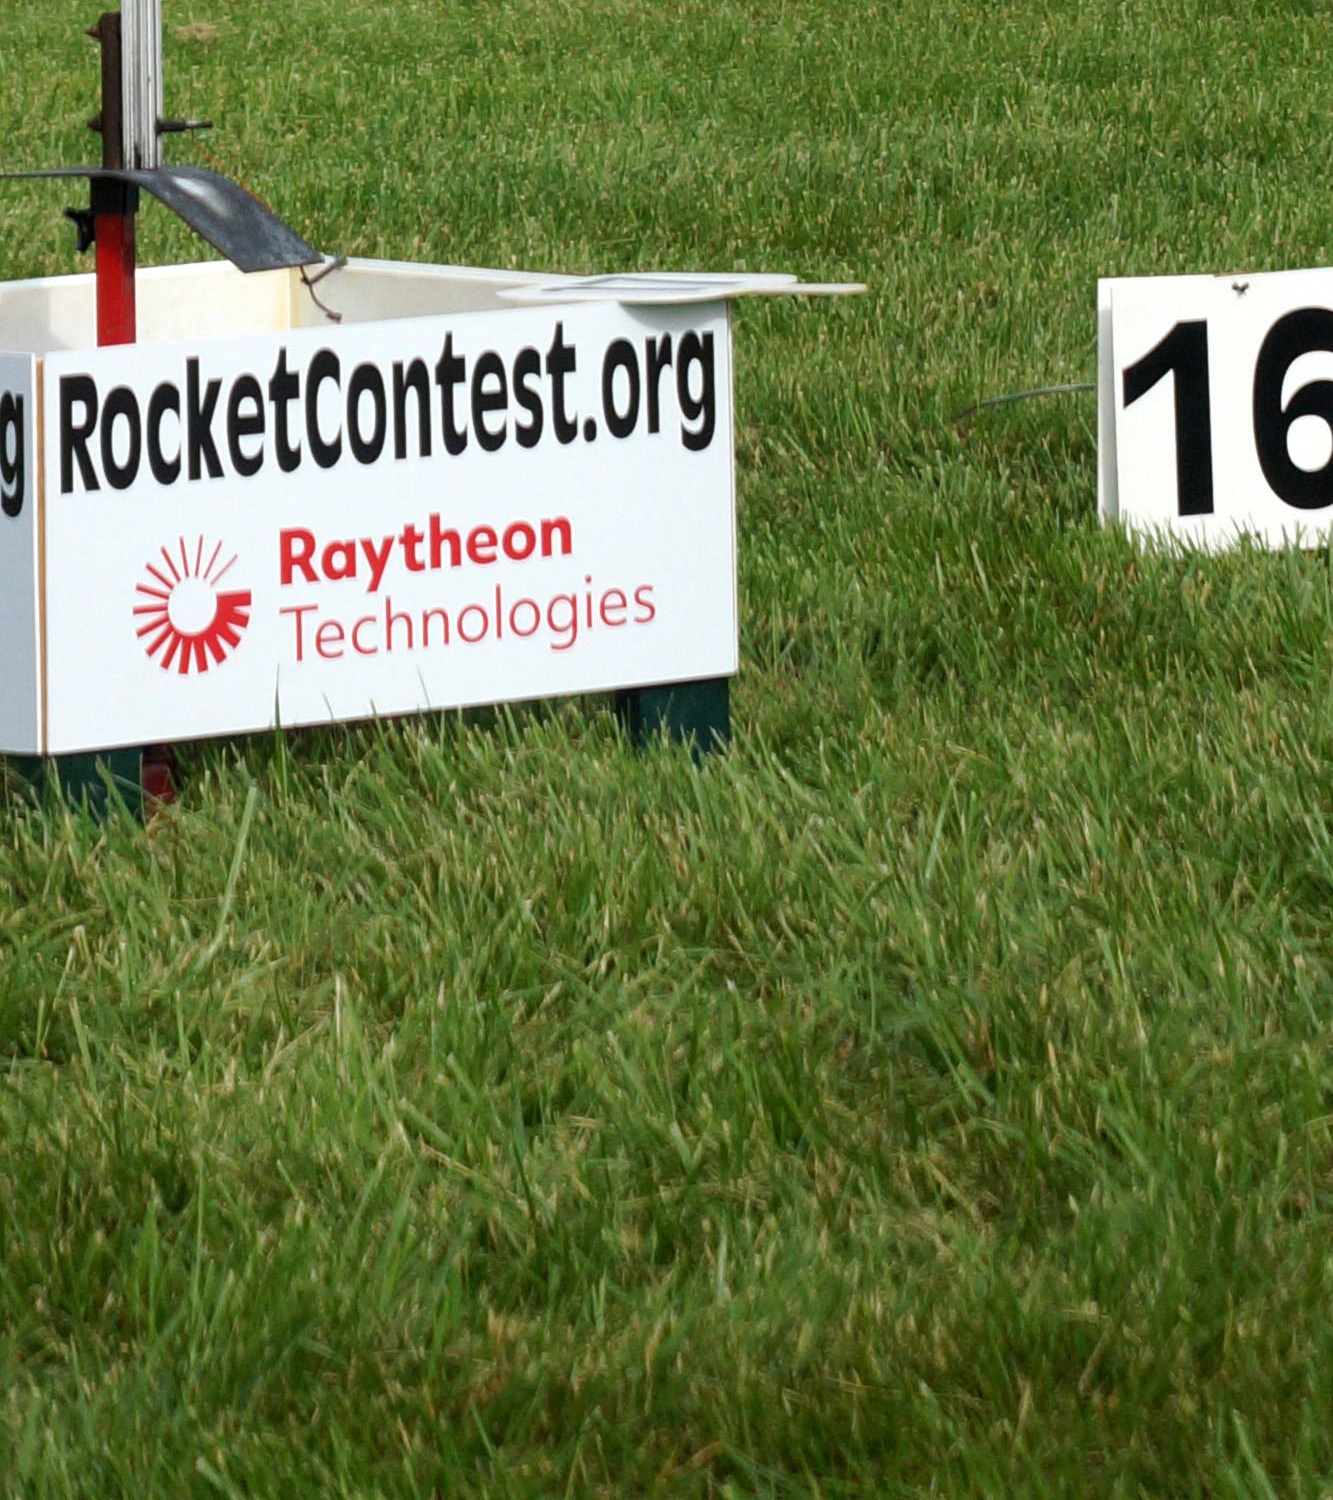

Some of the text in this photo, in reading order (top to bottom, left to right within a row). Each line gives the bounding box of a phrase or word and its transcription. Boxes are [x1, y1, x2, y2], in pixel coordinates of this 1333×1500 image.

[59, 320, 715, 494] RocketContest.org
[279, 512, 573, 592] Raytheon
[279, 574, 656, 662] Technologies
